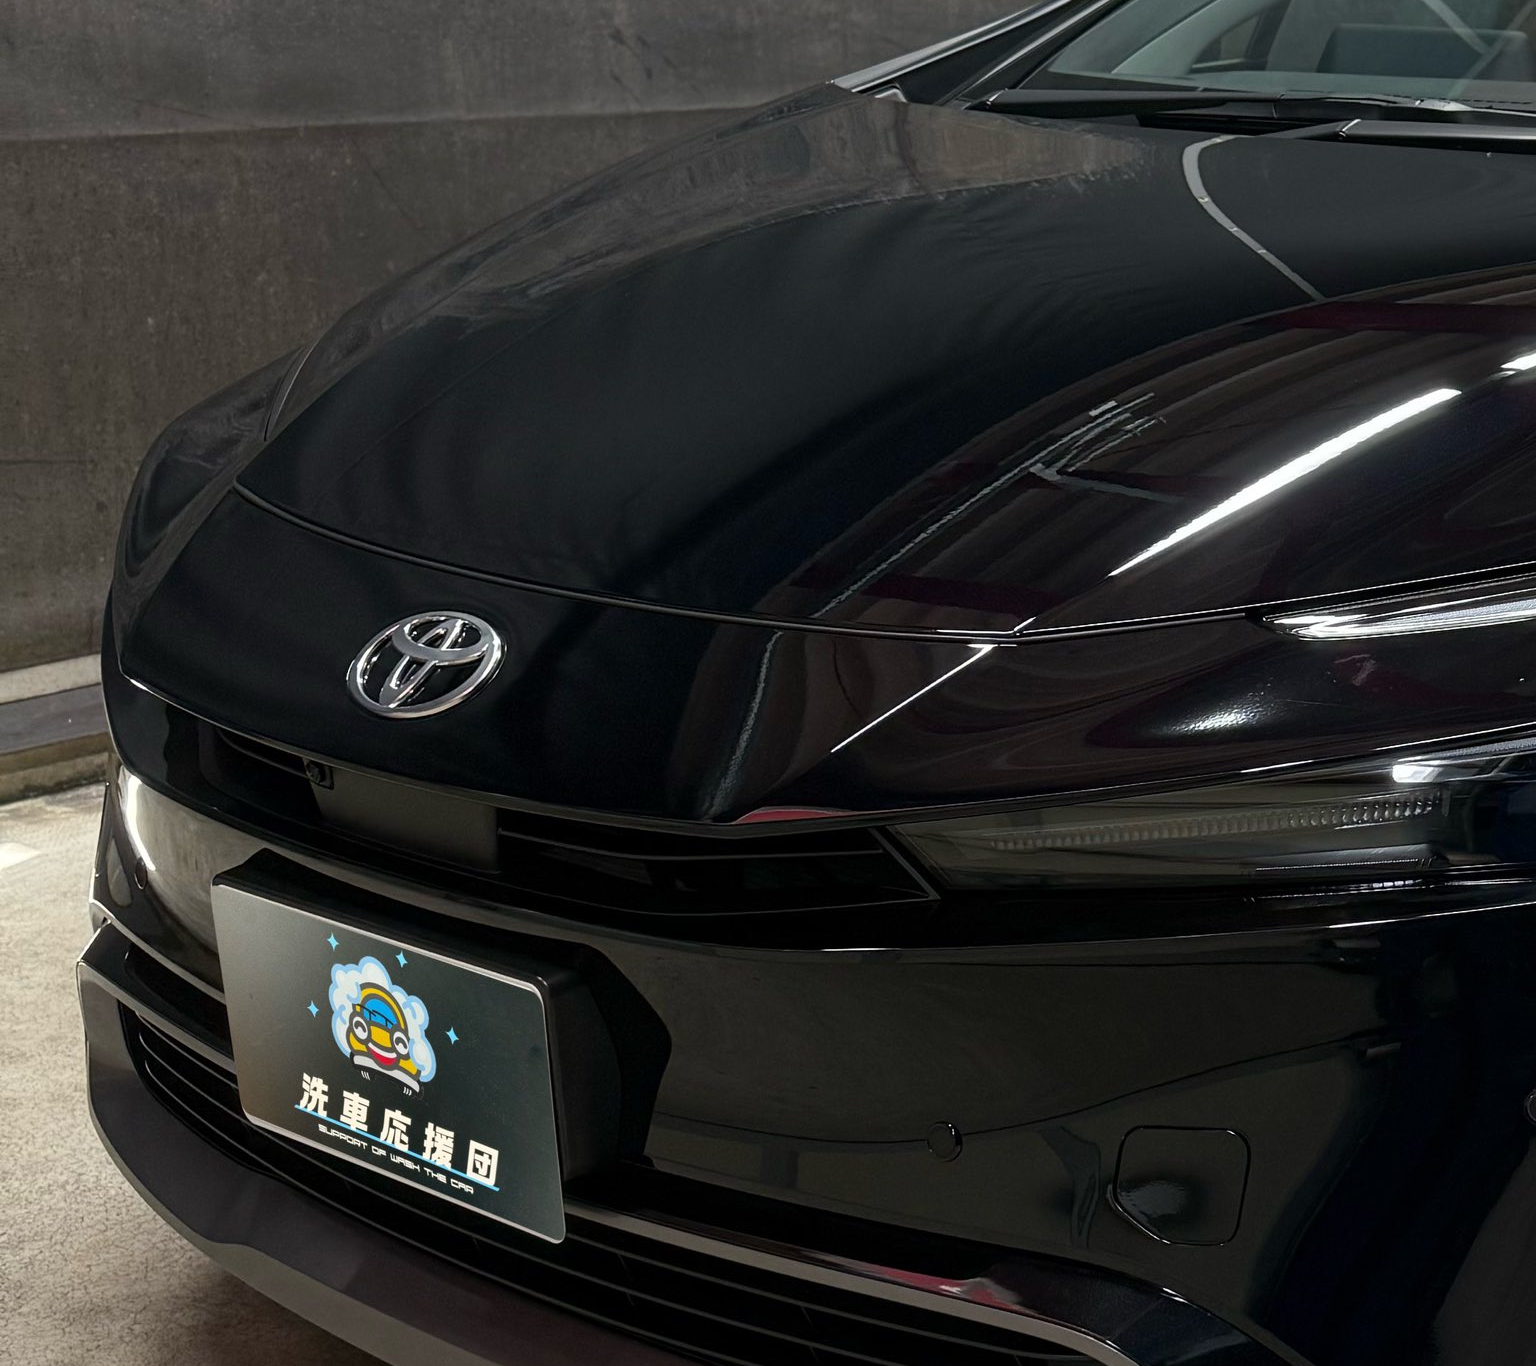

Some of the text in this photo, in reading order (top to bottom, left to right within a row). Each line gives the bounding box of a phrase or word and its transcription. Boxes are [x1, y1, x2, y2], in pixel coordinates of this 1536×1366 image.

[300, 1073, 499, 1187] 洗車応援団
[317, 1123, 474, 1195] SUPPORT OF WASH THE CAR
